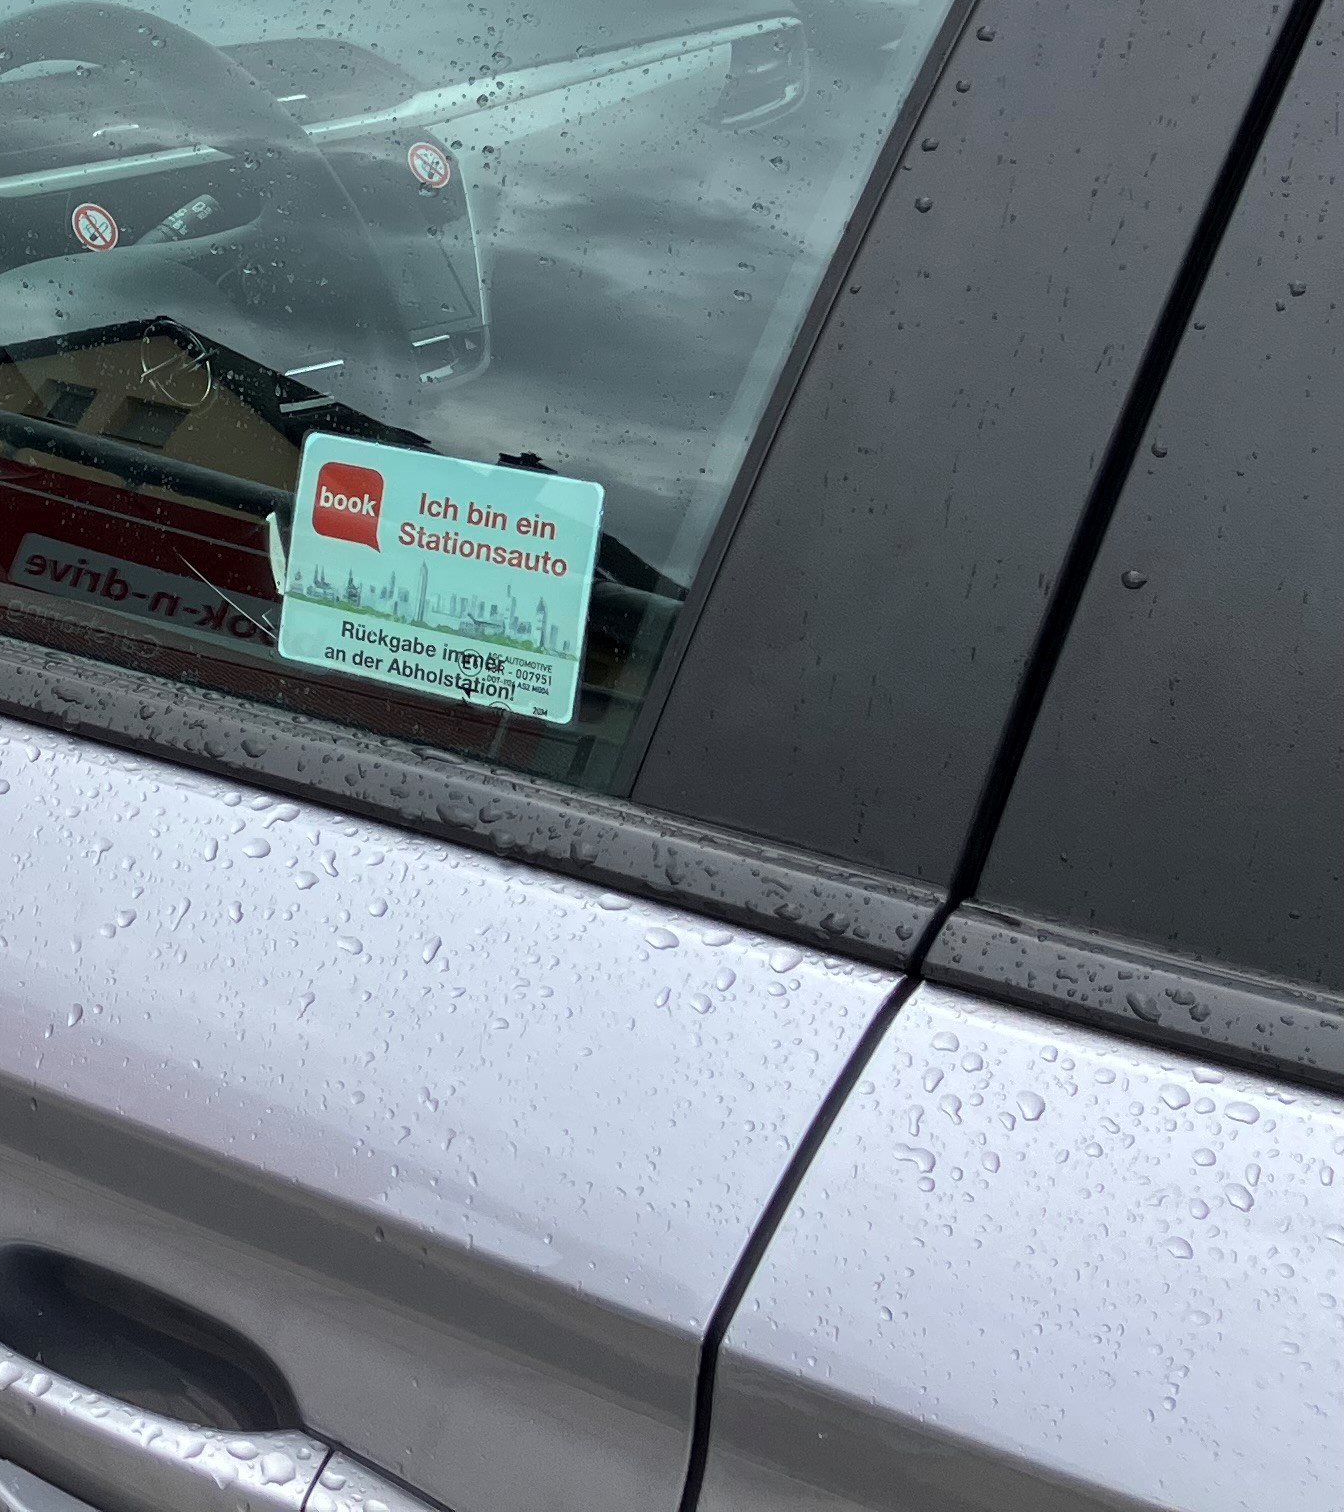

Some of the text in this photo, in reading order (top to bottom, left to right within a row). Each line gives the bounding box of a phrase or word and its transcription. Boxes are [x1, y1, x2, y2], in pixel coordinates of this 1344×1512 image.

[319, 486, 376, 517] book
[418, 492, 556, 540] Ich bin ein
[398, 522, 568, 577] Stationsauto
[341, 620, 505, 671] Rückgabe immer
[505, 656, 552, 673] AUTOMOTIVE
[324, 645, 346, 662] an
[352, 649, 383, 670] der
[387, 657, 516, 701] Abholstation!
[515, 668, 552, 686] 007951
